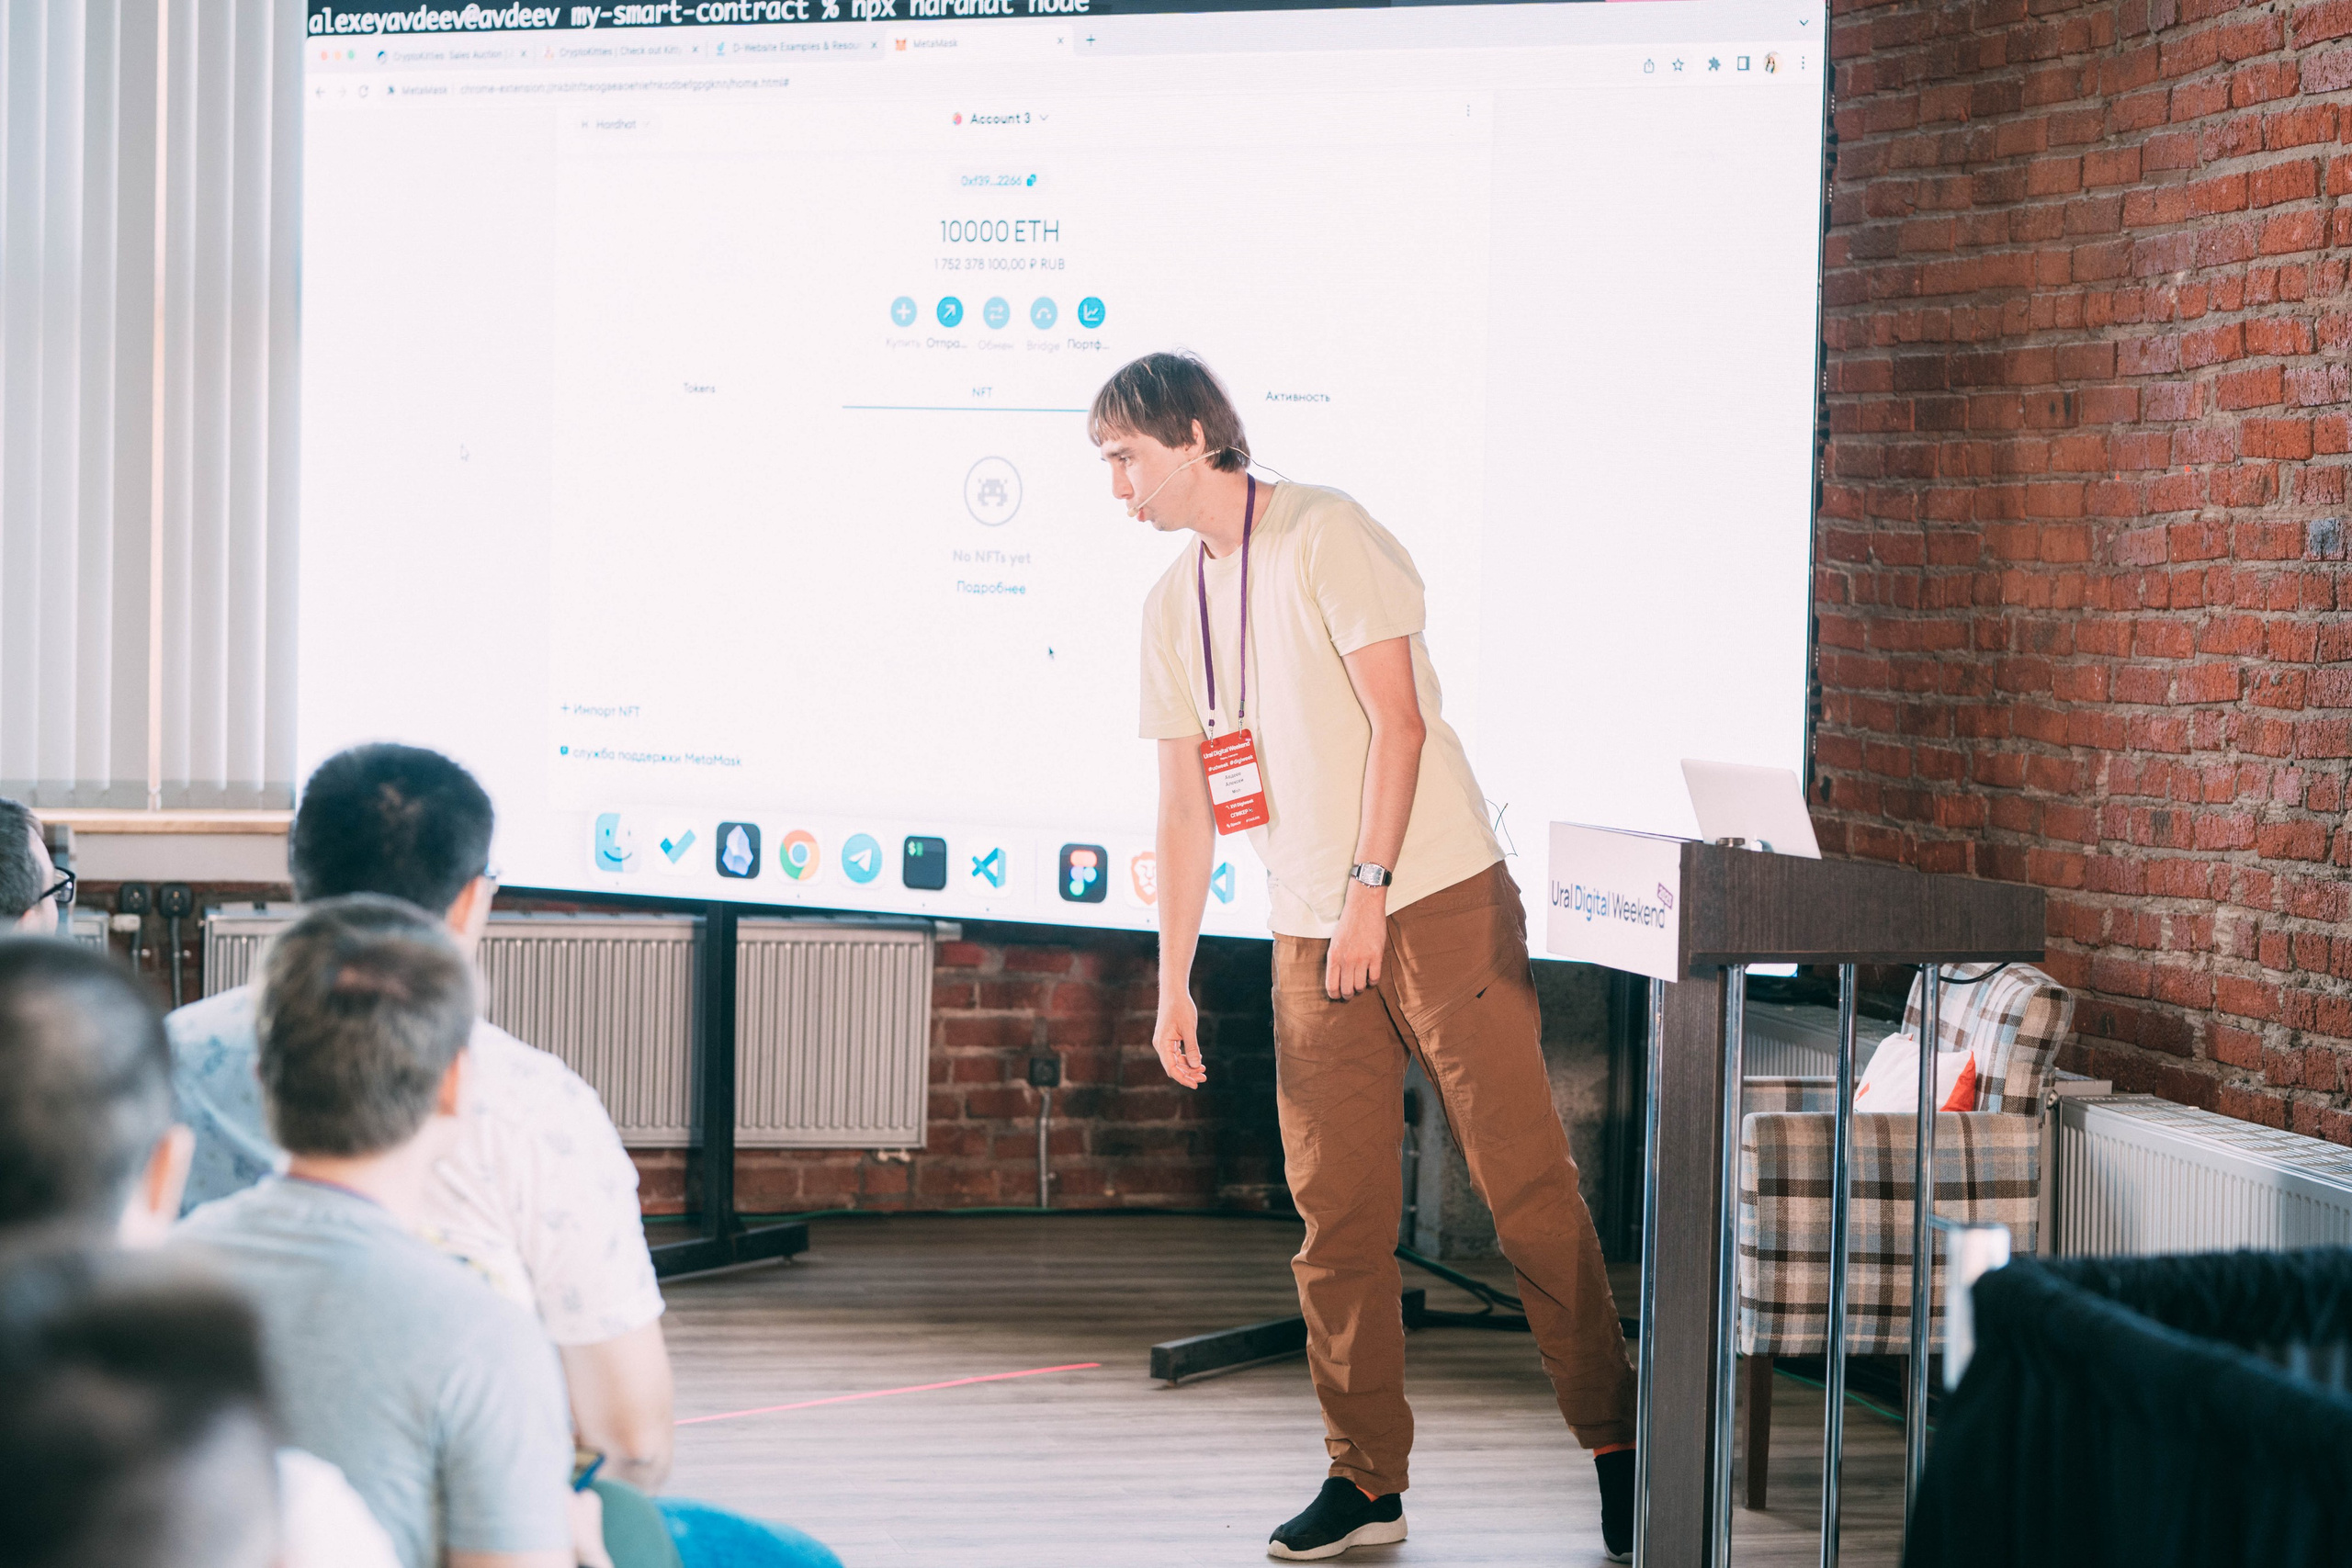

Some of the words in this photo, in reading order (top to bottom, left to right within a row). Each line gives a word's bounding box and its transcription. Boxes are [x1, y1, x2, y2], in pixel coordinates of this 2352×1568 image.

[309, 2, 560, 35] alexeyavdeev@avdeev
[571, 0, 809, 28] my-smart-contract
[852, 0, 897, 21] npx
[970, 112, 1021, 124] Account
[1024, 112, 1031, 124] 3
[941, 220, 1009, 243] 10000
[1015, 220, 1059, 243] ETH
[1040, 258, 1065, 270] RUB
[1026, 340, 1060, 353] Bridge
[684, 382, 716, 393] Tokens
[972, 387, 993, 398] NFT
[1265, 390, 1330, 402] Активность
[953, 550, 971, 562] No
[975, 550, 1006, 563] NFTs
[1010, 552, 1031, 567] yet
[956, 581, 1026, 595] Подробнее
[618, 705, 640, 716] NFT
[684, 752, 741, 766] MetaMask
[1552, 879, 1573, 909] Ural
[1575, 885, 1611, 921] Digital
[1612, 892, 1666, 929] Weekend
